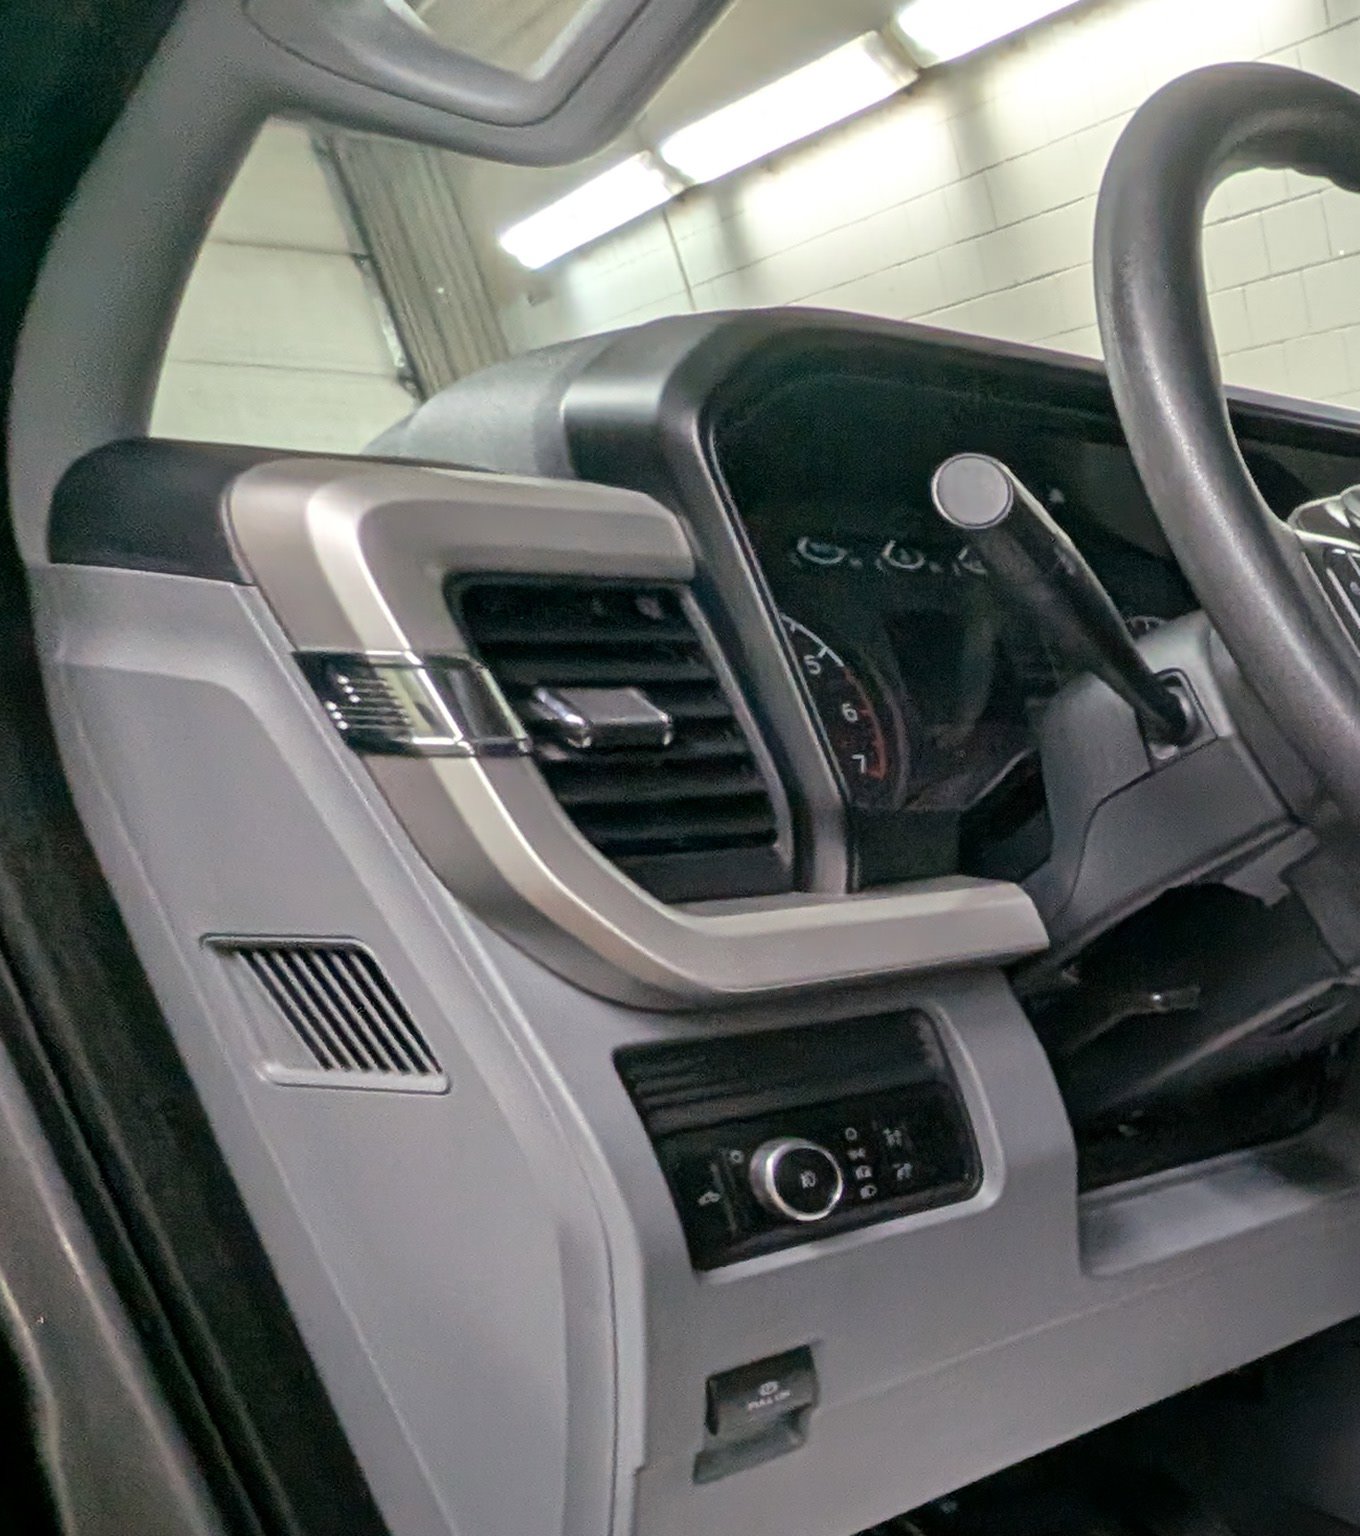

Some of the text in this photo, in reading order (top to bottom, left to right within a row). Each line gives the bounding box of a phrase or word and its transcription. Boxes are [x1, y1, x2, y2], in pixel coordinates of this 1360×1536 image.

[802, 653, 822, 675] 5
[842, 703, 859, 723] 6
[851, 754, 867, 774] 7
